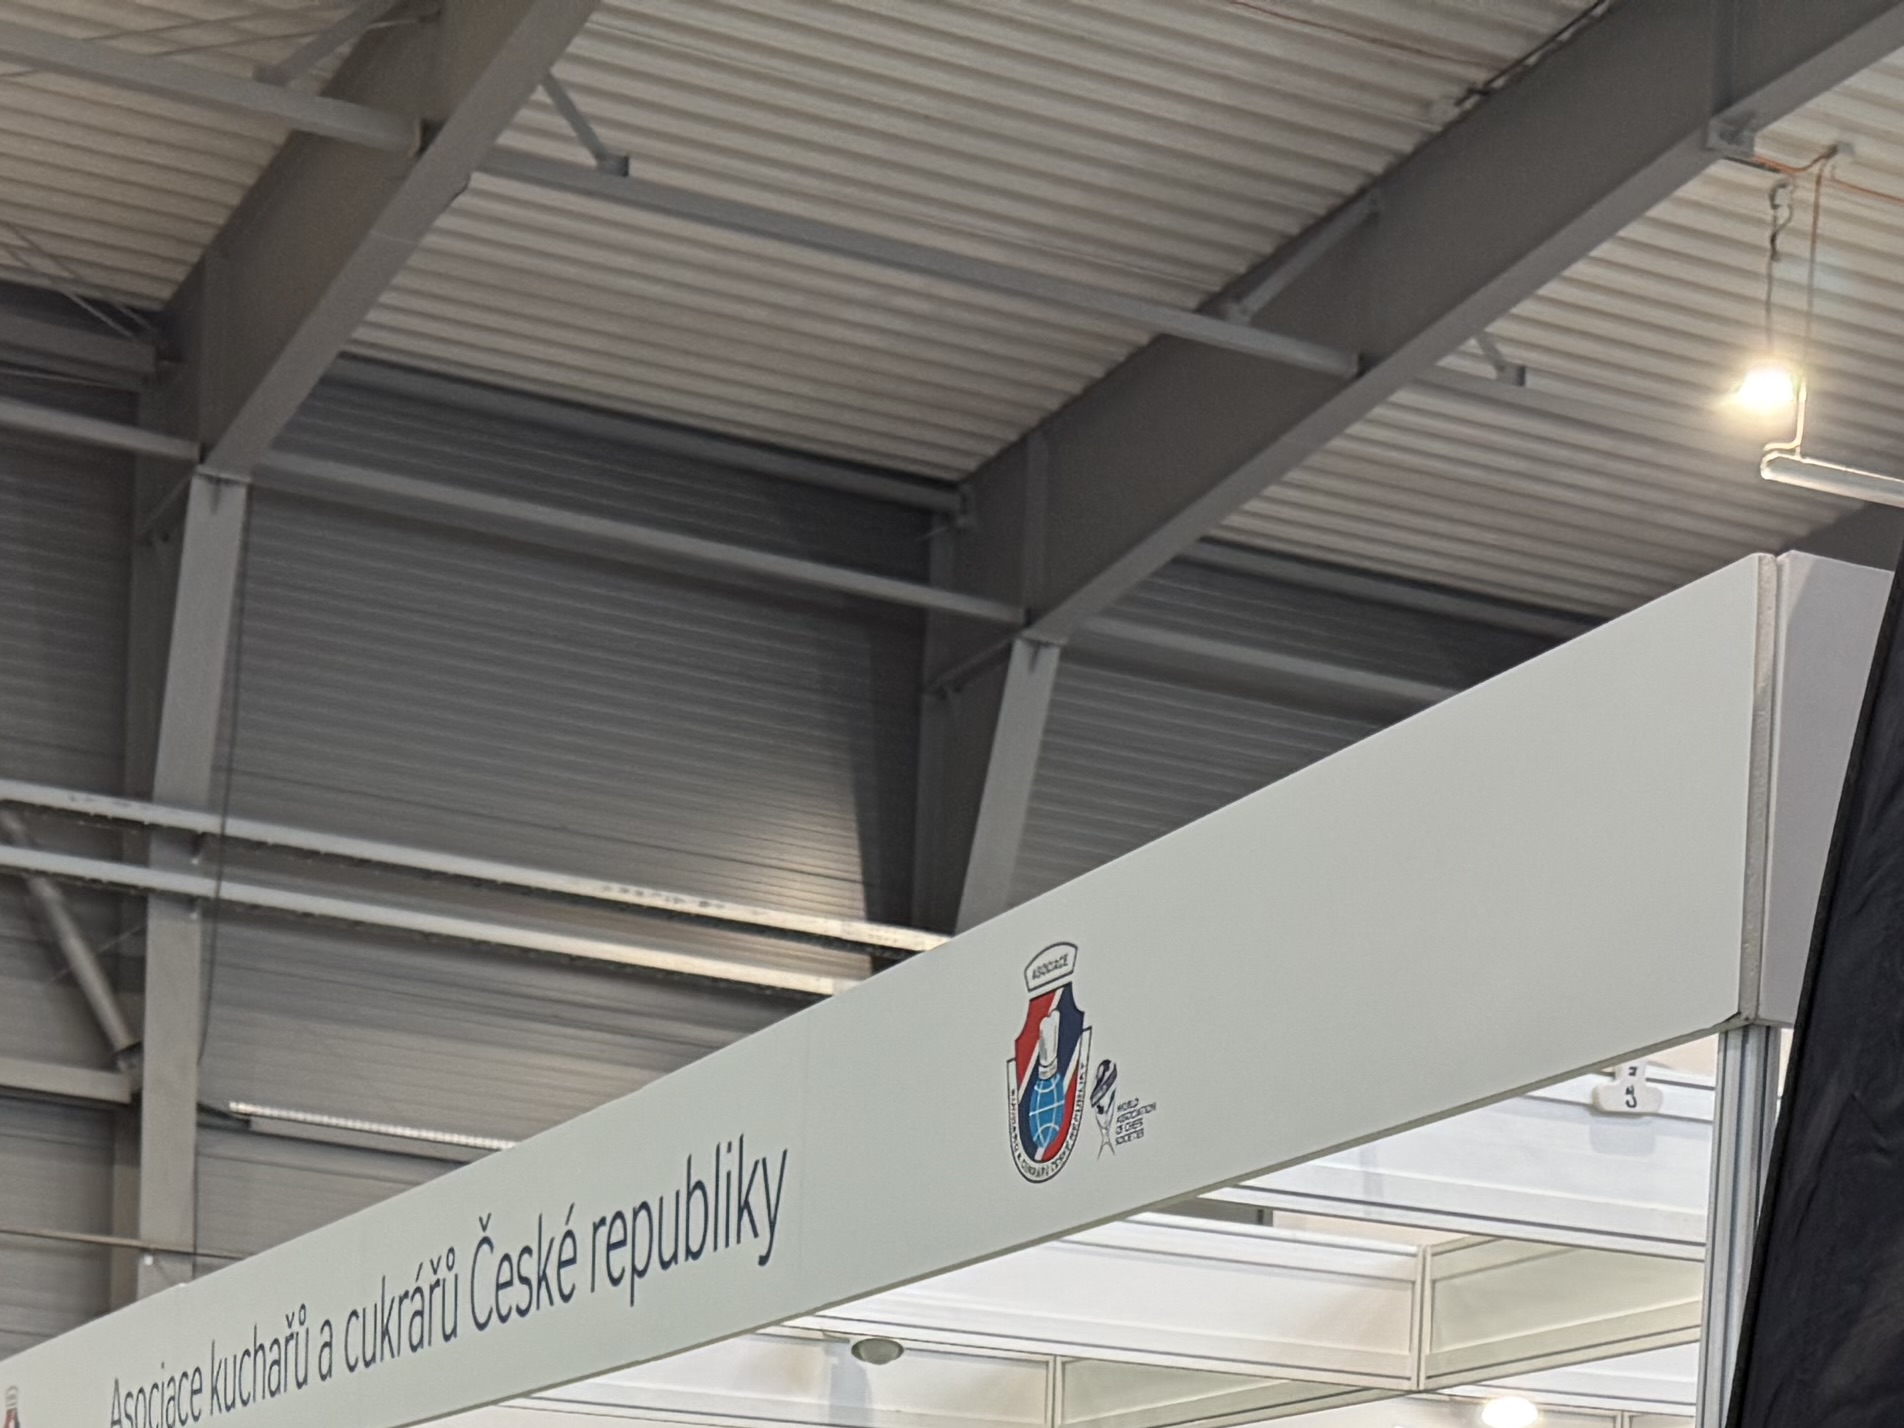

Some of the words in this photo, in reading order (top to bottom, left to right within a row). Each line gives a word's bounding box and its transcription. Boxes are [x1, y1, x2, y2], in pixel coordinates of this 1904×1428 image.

[210, 1304, 310, 1417] kuchařů
[319, 1320, 335, 1381] a
[344, 1247, 459, 1374] cukrářů
[470, 1203, 578, 1332] České
[590, 1134, 790, 1306] republiky
